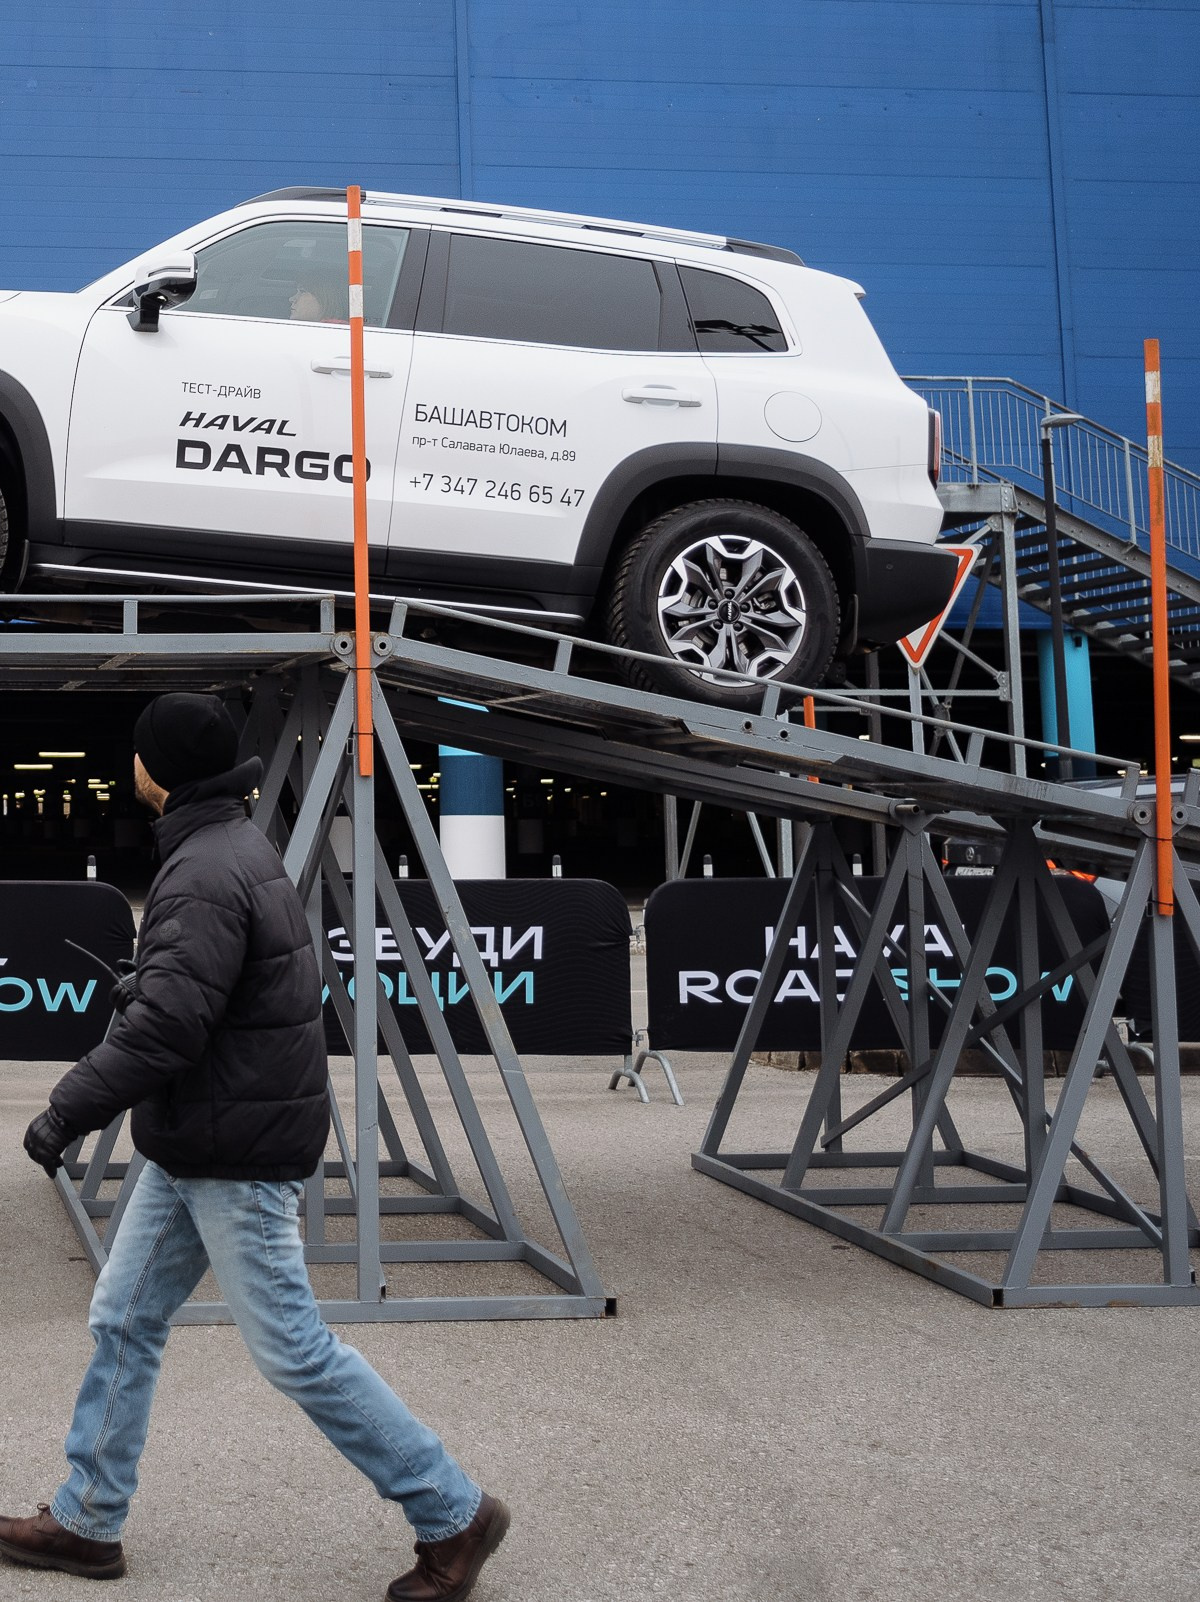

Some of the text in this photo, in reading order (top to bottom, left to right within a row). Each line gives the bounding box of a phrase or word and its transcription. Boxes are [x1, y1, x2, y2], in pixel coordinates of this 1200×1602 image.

[181, 381, 262, 400] ТЕСТ-ДРАЙВ
[179, 411, 297, 437] HAVAL
[414, 403, 568, 438] БАШАВТОКОМ
[176, 438, 372, 484] DARGO
[411, 435, 576, 462] пр-т Салавата Юлаева, д.89
[409, 473, 585, 508] +7 347 246 65 47
